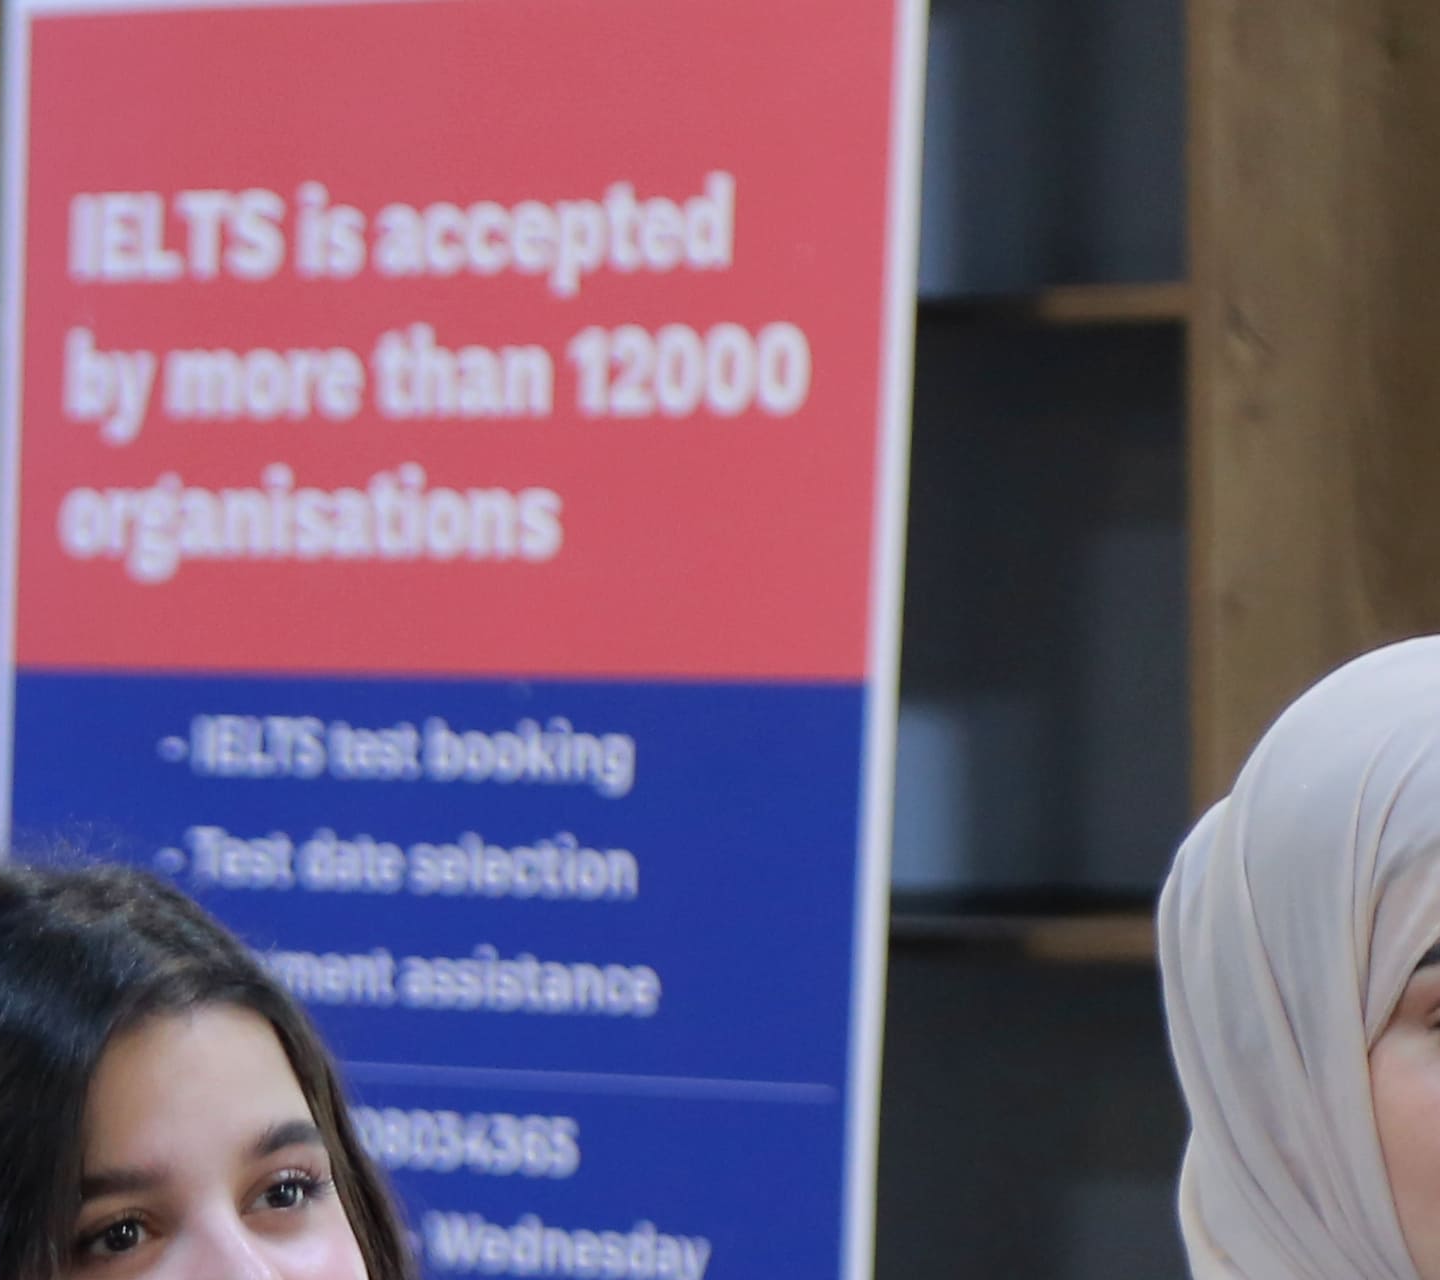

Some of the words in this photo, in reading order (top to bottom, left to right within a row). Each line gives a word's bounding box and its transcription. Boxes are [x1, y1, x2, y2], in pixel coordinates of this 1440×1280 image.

[72, 191, 282, 279] IELTS
[299, 184, 364, 275] is
[377, 174, 733, 294] accepted
[66, 330, 154, 441] by
[167, 350, 362, 417] more
[375, 325, 551, 416] than
[571, 324, 808, 414] 12000
[61, 465, 560, 580] organisations
[194, 717, 323, 774] IELTS
[328, 725, 419, 775] test
[426, 720, 632, 793] booking
[191, 828, 294, 885] Test
[299, 831, 402, 889] date
[407, 836, 636, 895] selection
[400, 947, 658, 1013] assistance
